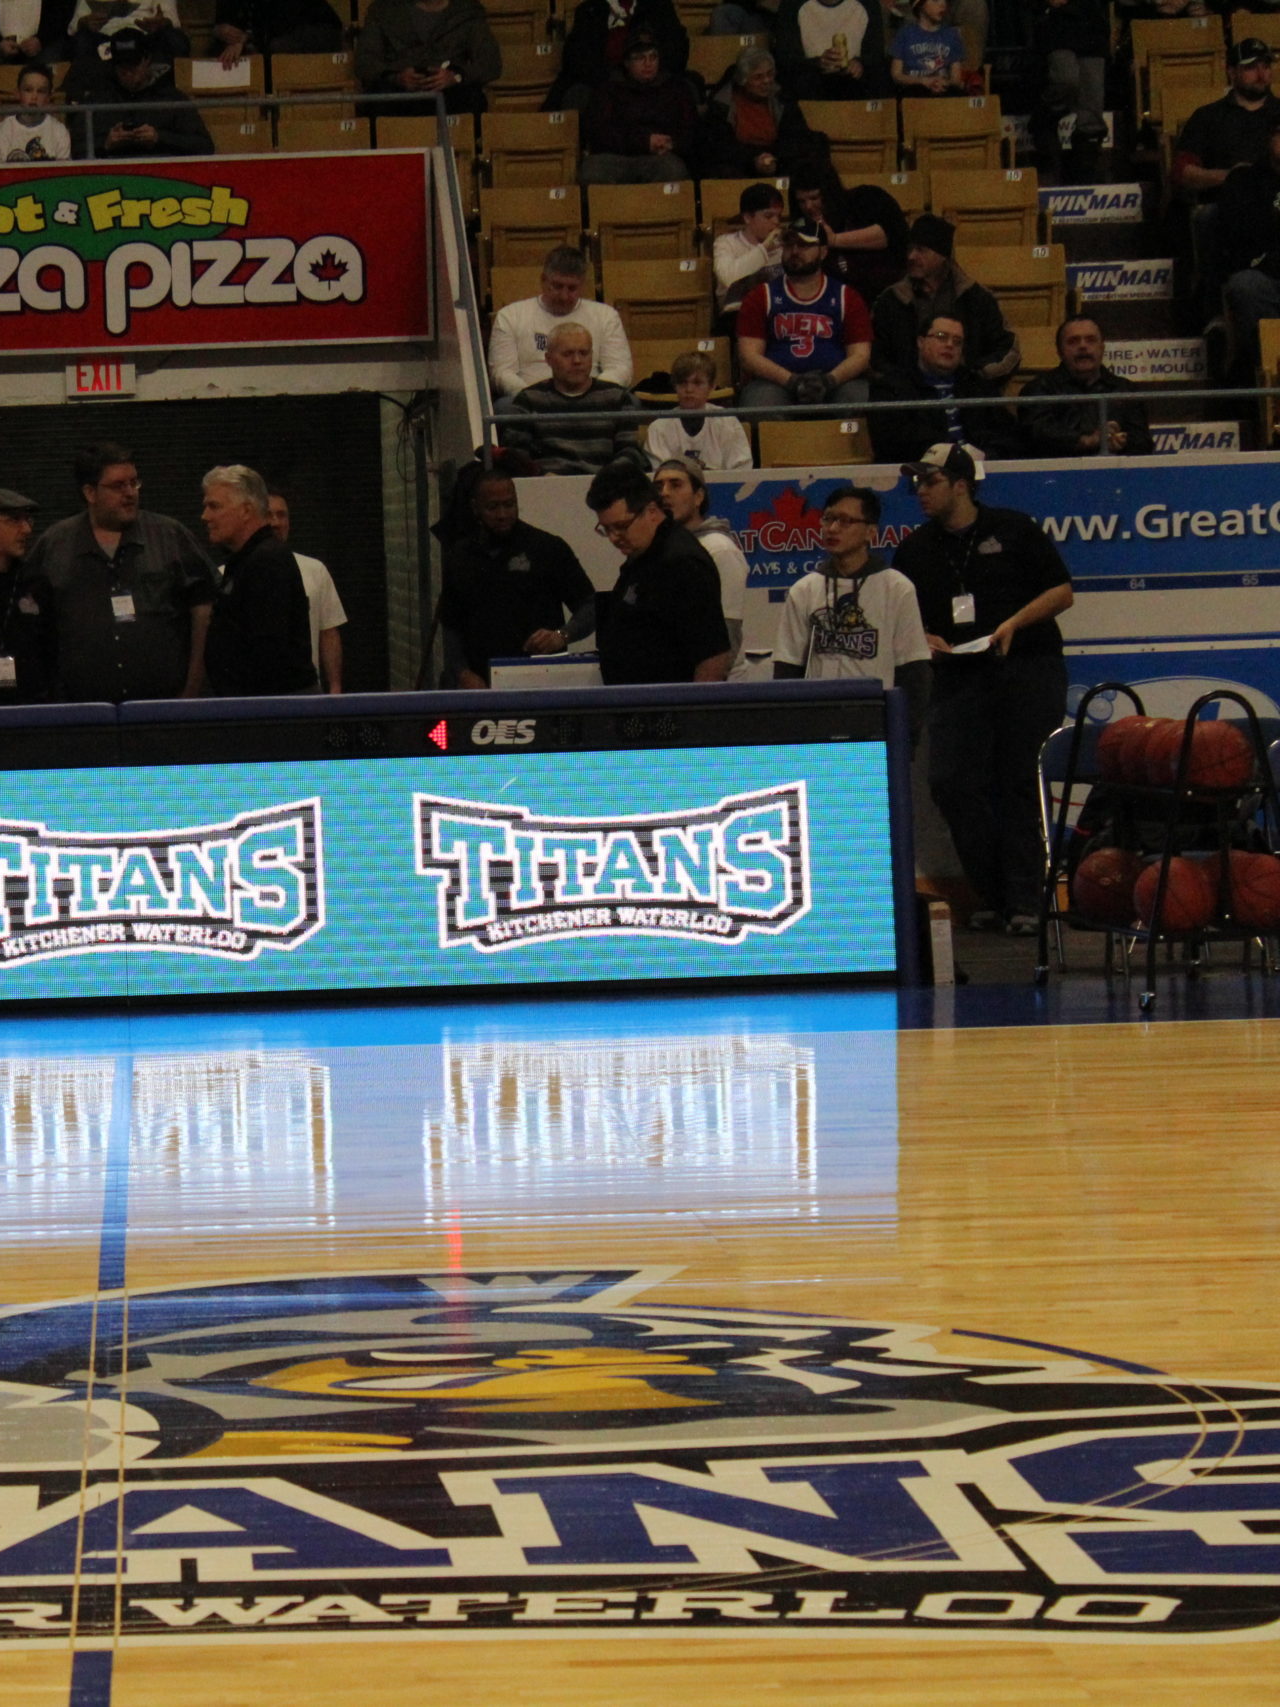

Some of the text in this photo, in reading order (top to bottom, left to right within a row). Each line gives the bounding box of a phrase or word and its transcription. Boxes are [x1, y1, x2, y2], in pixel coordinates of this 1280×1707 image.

[53, 201, 79, 225] &
[86, 186, 250, 232] Fresh
[1047, 193, 1138, 212] WINMAR
[106, 234, 365, 335] pizza
[1075, 269, 1170, 288] WINMAR
[774, 312, 834, 340] NETS
[790, 335, 815, 358] 3
[1147, 347, 1201, 358] WATER
[75, 360, 123, 392] EXIT
[1108, 363, 1204, 375] IND MOULD
[1033, 501, 1280, 543] ww.Great
[786, 562, 798, 574] &
[1242, 574, 1259, 586] 65
[1129, 578, 1146, 590] 64
[470, 719, 537, 745] OES
[431, 801, 793, 929] TITANS
[486, 908, 732, 943] KITCHENER WATERLOO
[1, 922, 248, 957] KITCHENER WATERLOO
[131, 1591, 1184, 1626] WATERLOO
